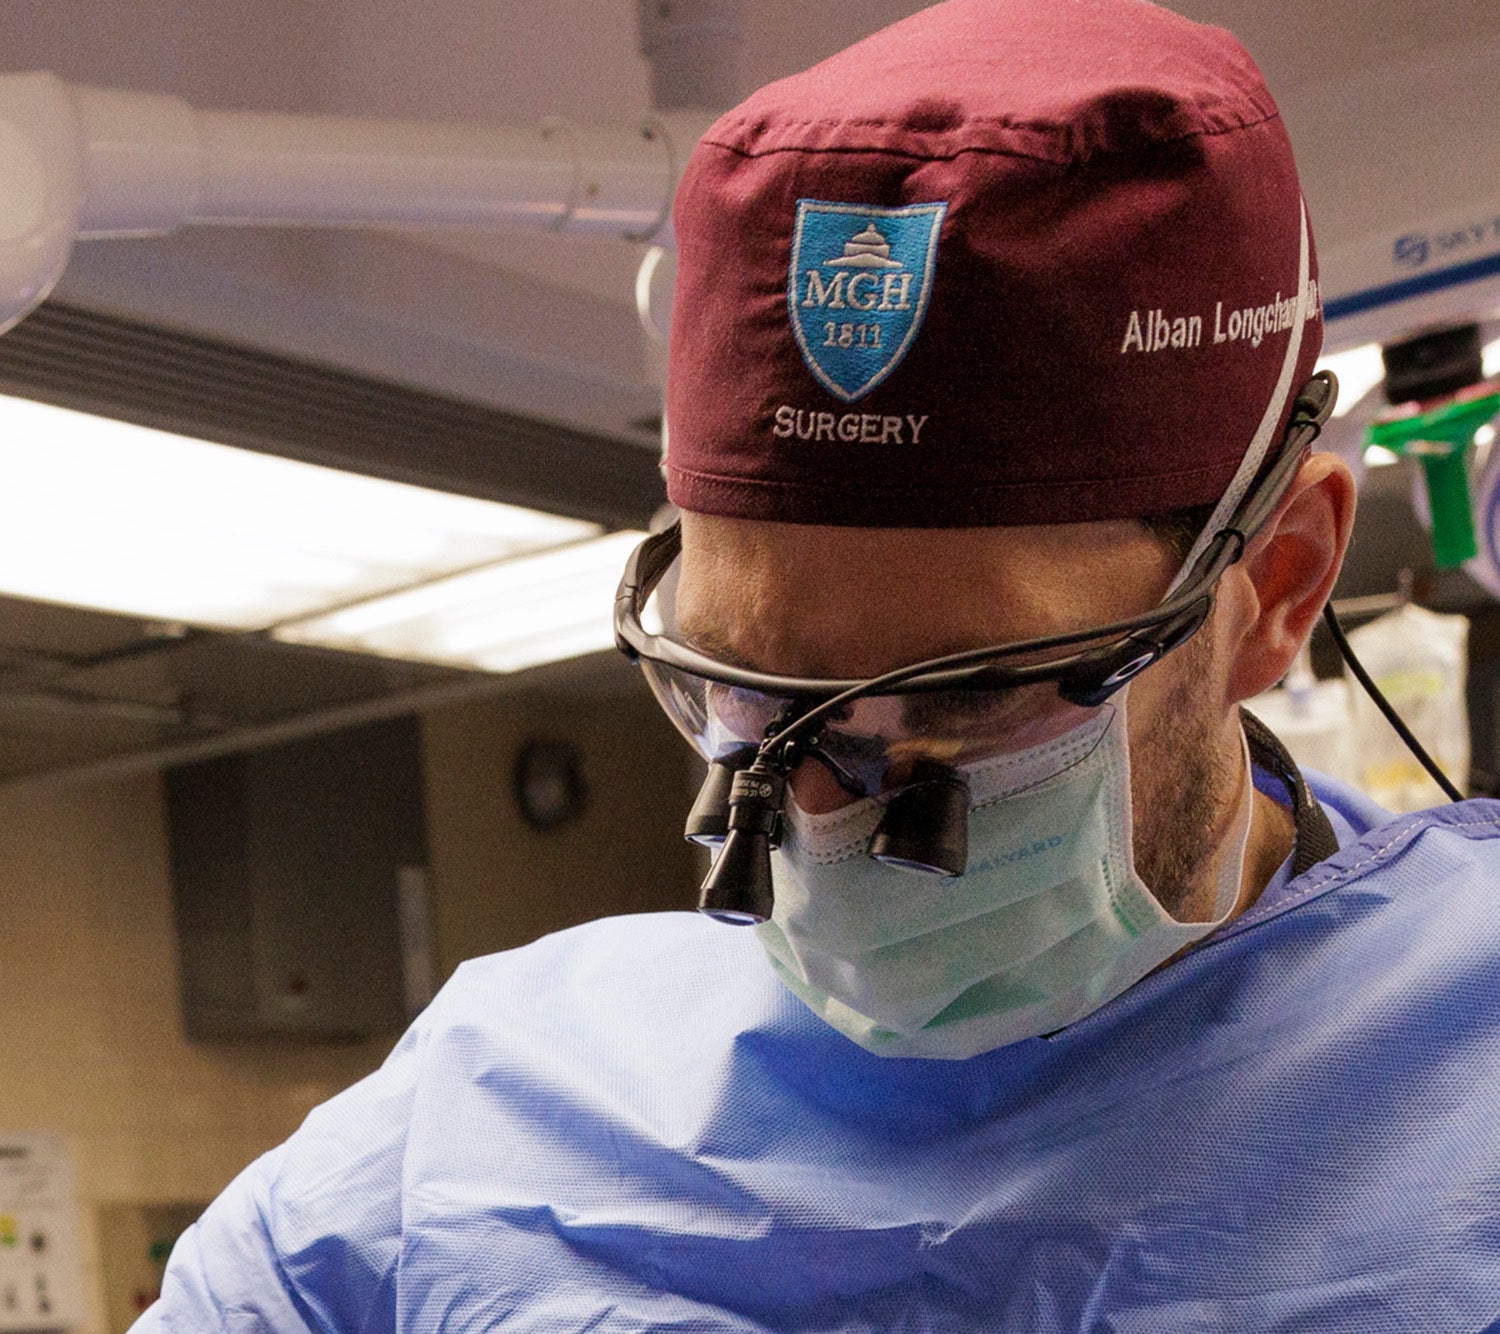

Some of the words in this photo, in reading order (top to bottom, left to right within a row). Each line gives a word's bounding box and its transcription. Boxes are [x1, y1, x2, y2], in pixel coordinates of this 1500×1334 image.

[801, 269, 916, 312] MGH
[822, 320, 883, 350] 1811
[1120, 308, 1203, 353] Alban
[772, 404, 930, 445] SURGERY
